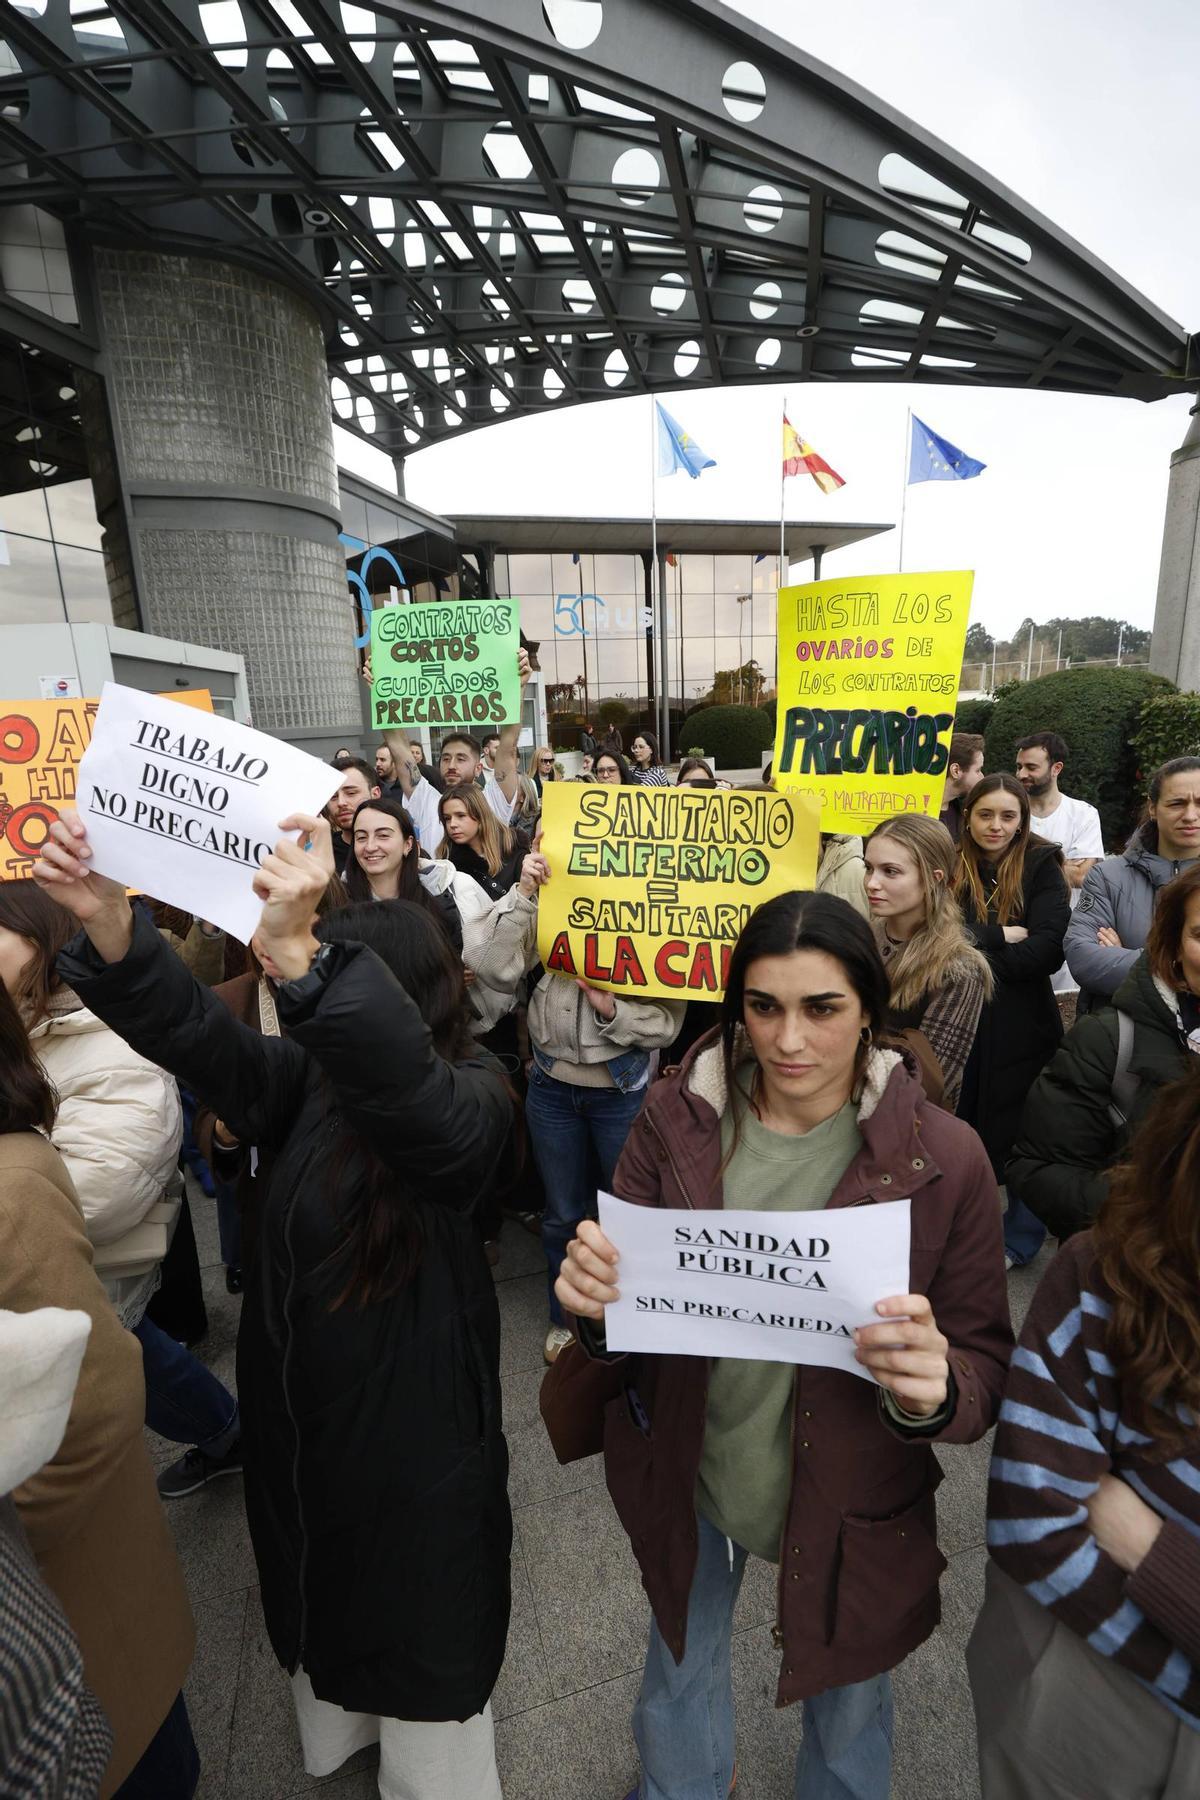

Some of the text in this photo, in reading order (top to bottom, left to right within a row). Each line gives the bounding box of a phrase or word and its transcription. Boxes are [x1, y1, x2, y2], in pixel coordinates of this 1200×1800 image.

[378, 605, 512, 642] CONTRATOS
[797, 592, 952, 632] HASTA LOS
[390, 634, 480, 663] CORTOS
[906, 637, 933, 657] DE
[375, 667, 499, 697] CUIDADOS
[798, 671, 955, 695] LOS CONTRATOS
[375, 691, 507, 724] PRECARIOS
[135, 720, 268, 780] TRABAJO
[89, 786, 127, 818] NO
[141, 762, 229, 812] DIGNO
[573, 790, 794, 849] SANITARIO
[567, 841, 770, 886] ENFERMO
[568, 897, 751, 940] SANITARI
[547, 931, 577, 976] A
[584, 933, 647, 986] LA
[674, 1226, 830, 1259] SANIDAD
[678, 1250, 827, 1289] PÚBLICA
[636, 1296, 853, 1337] SIN PRECARIEDA
